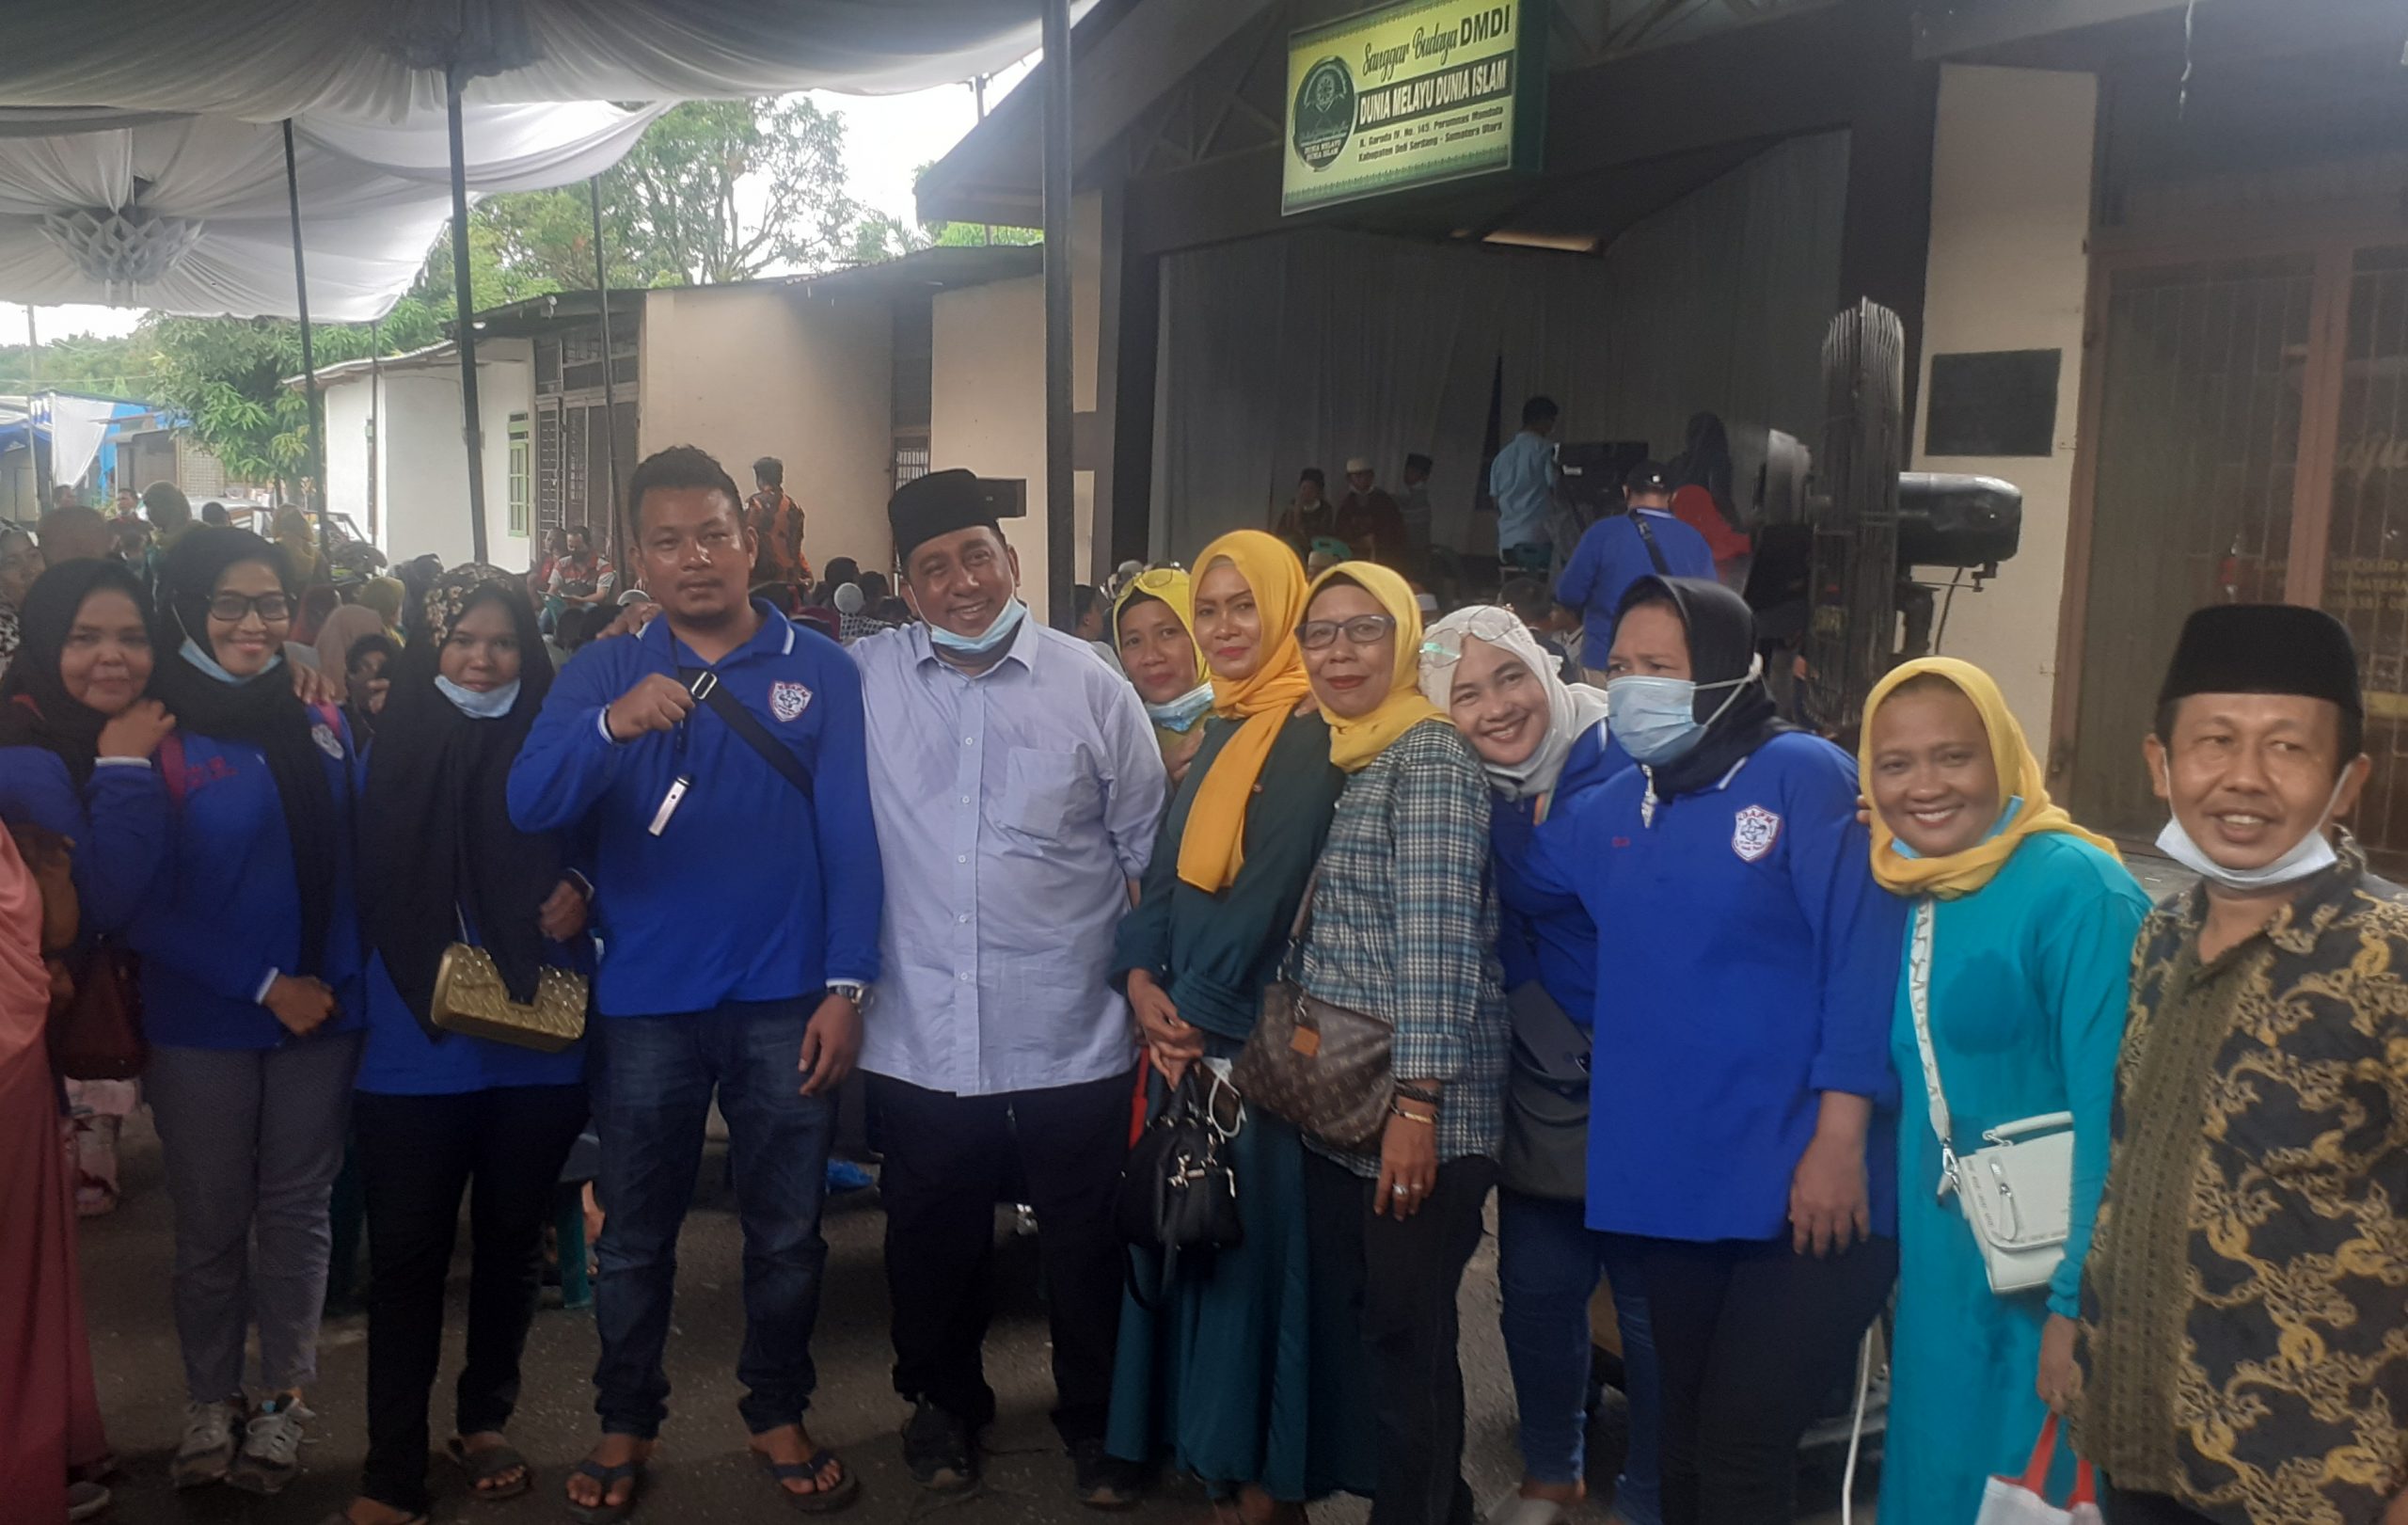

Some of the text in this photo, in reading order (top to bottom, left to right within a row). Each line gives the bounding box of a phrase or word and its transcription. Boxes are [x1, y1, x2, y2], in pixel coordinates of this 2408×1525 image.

[1363, 5, 1510, 83] Sanggar Budaya DMDI
[1360, 58, 1507, 125] DUNIA MELAYU DUNIA ISLAM
